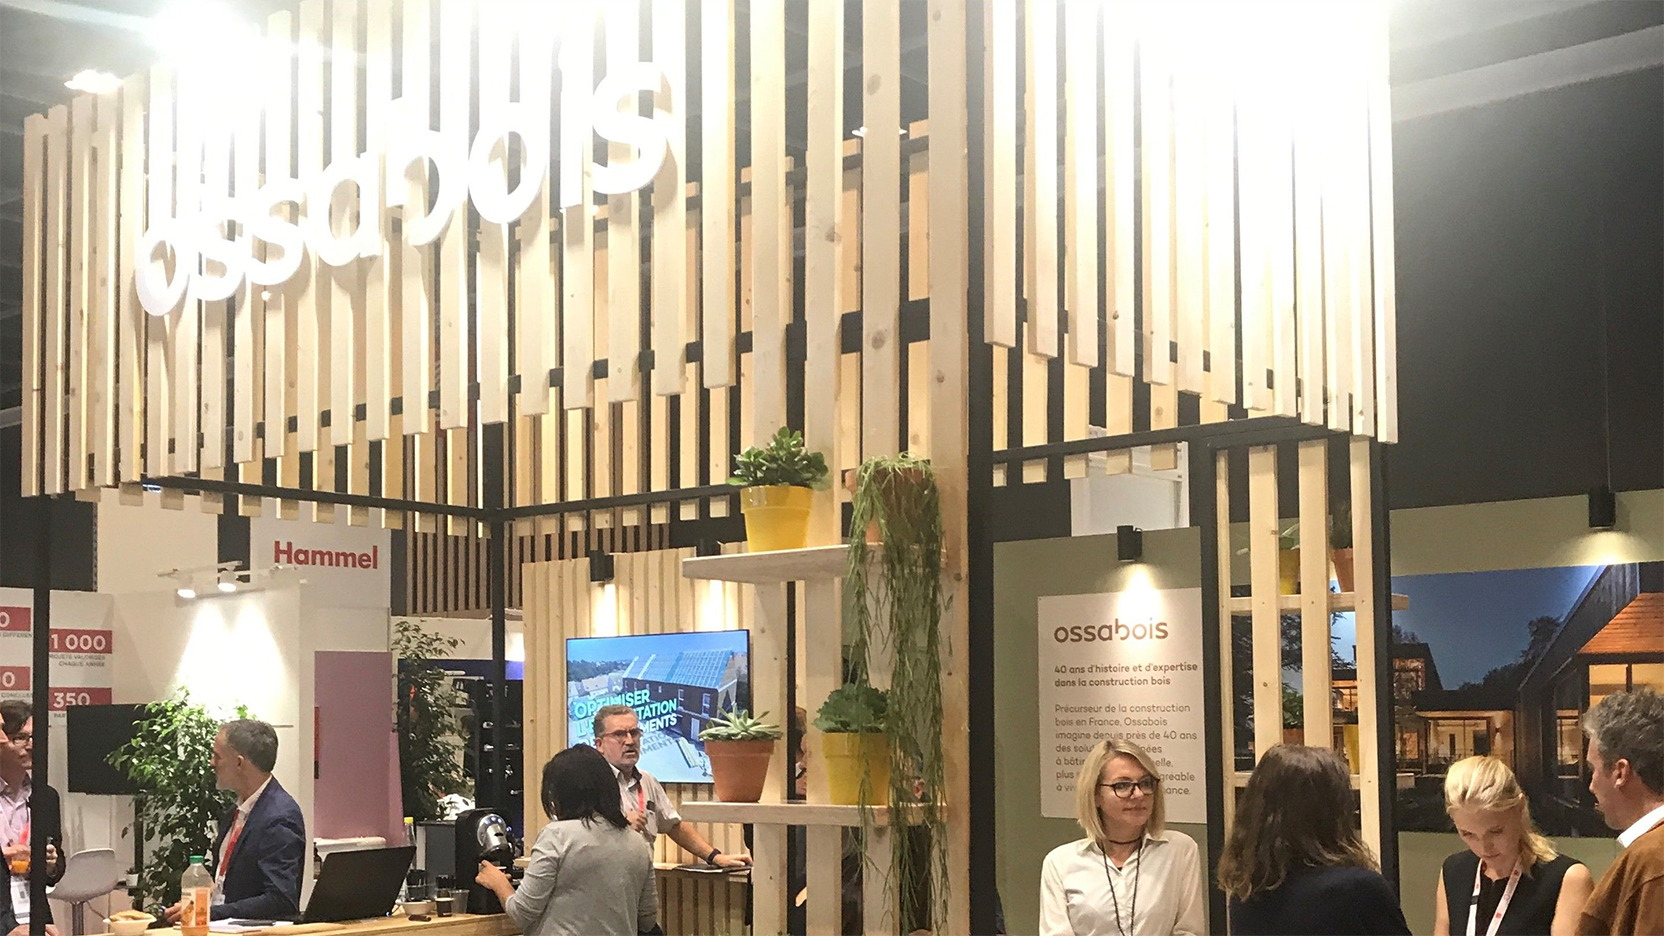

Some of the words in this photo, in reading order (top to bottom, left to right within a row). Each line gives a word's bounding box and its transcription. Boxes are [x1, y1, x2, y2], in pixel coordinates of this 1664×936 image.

[135, 31, 676, 316] ossabois
[274, 540, 378, 570] Hammel
[1053, 617, 1169, 643] ossabois
[65, 634, 106, 650] 000
[1054, 665, 1067, 674] 40
[1069, 666, 1086, 674] ans
[1087, 663, 1130, 673] d'histoire
[1132, 663, 1143, 673] et
[1145, 661, 1198, 675] d'expertise
[1054, 678, 1077, 688] dans
[1078, 678, 1087, 687] la
[1089, 676, 1149, 687] construction
[1150, 675, 1171, 686] bois
[53, 692, 91, 708] 350
[1054, 703, 1103, 713] Précurseur
[1104, 703, 1116, 713] de
[1118, 703, 1127, 713] la
[1129, 702, 1191, 713] construction
[1055, 717, 1074, 727] bois
[1075, 719, 1087, 727] en
[1123, 717, 1168, 727] Ossabois
[1055, 730, 1091, 742] imagine
[1093, 730, 1124, 741] depuis
[1126, 730, 1147, 741] près
[1148, 730, 1161, 740] de
[1163, 730, 1177, 740] 40
[1179, 732, 1198, 740] ans
[1055, 744, 1072, 753] des
[1055, 756, 1062, 766] à
[1055, 770, 1075, 781] plus
[1159, 772, 1196, 783] gréable
[1056, 783, 1063, 792] à
